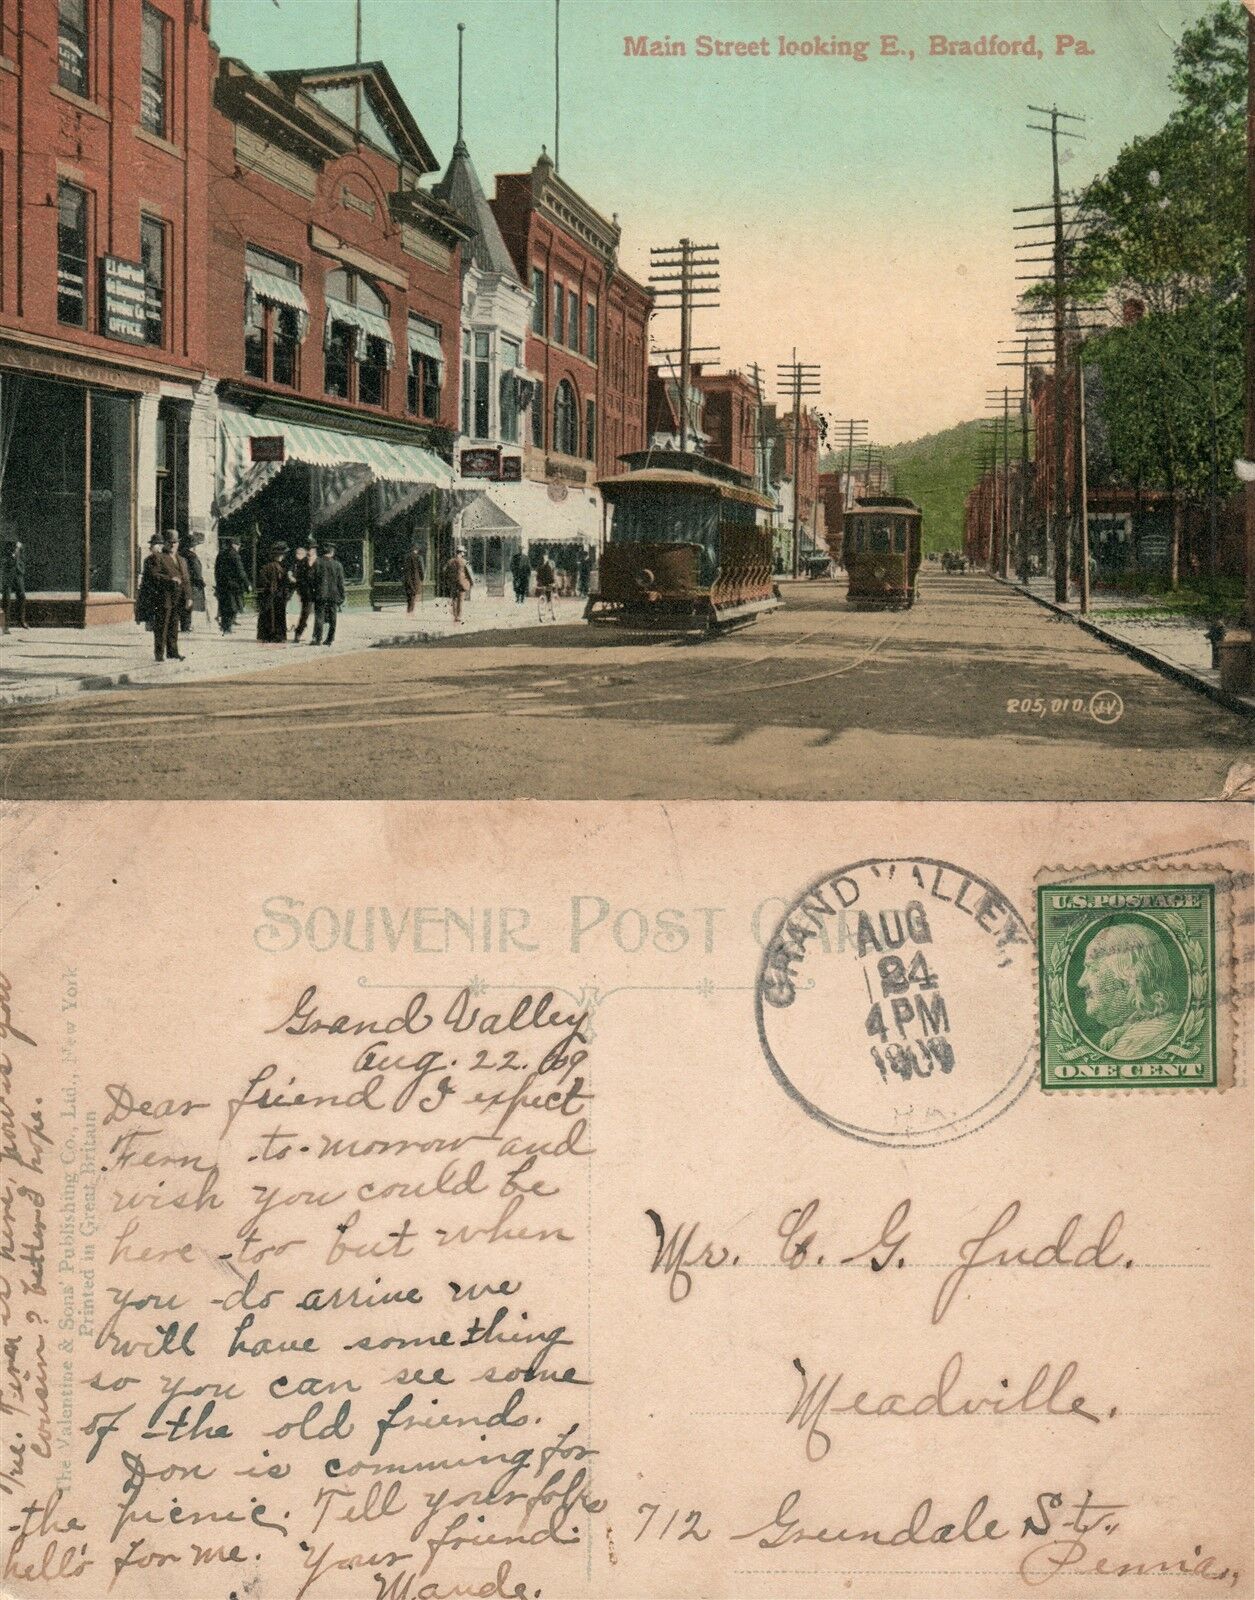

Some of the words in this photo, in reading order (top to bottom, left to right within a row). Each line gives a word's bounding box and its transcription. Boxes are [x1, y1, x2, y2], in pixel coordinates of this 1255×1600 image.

[570, 896, 726, 955] POST
[764, 876, 860, 1008] GRAND
[857, 900, 932, 957] AUG
[61, 967, 78, 1012] York
[61, 1021, 78, 1062] New
[264, 986, 434, 1036] Grand
[444, 988, 589, 1075] Valley
[1055, 1064, 1117, 1079] ONE
[1120, 1063, 1202, 1079] CENT
[103, 1084, 209, 1126] Dear
[80, 1111, 97, 1175] Britain
[498, 1121, 596, 1158] and
[59, 1174, 79, 1273] Publishing
[79, 1185, 98, 1238] Great
[113, 1163, 224, 1212] wish
[236, 1184, 345, 1239] you
[358, 1162, 487, 1200] could
[500, 1163, 561, 1199] be
[79, 1244, 95, 1261] in
[109, 1216, 200, 1265] here
[325, 1212, 415, 1266] but
[437, 1196, 575, 1244] when
[645, 1209, 740, 1302] Mr.
[930, 1200, 1134, 1325] Judd.
[78, 1269, 95, 1336] Printed
[96, 1287, 192, 1350] you
[448, 1279, 522, 1302] we
[58, 1338, 74, 1353] &
[111, 1321, 195, 1359] will
[228, 1314, 320, 1357] have
[56, 1361, 73, 1449] Valentine
[82, 1367, 139, 1389] so
[147, 1371, 245, 1427] you
[270, 1376, 362, 1400] can
[381, 1365, 455, 1386] see
[471, 1359, 592, 1386] some
[786, 1351, 1117, 1462] Meadville.
[80, 1403, 136, 1464] of
[263, 1401, 356, 1440] old
[56, 1460, 73, 1491] The
[235, 1450, 291, 1480] is
[303, 1480, 407, 1533] Tell
[633, 1503, 712, 1541] 712
